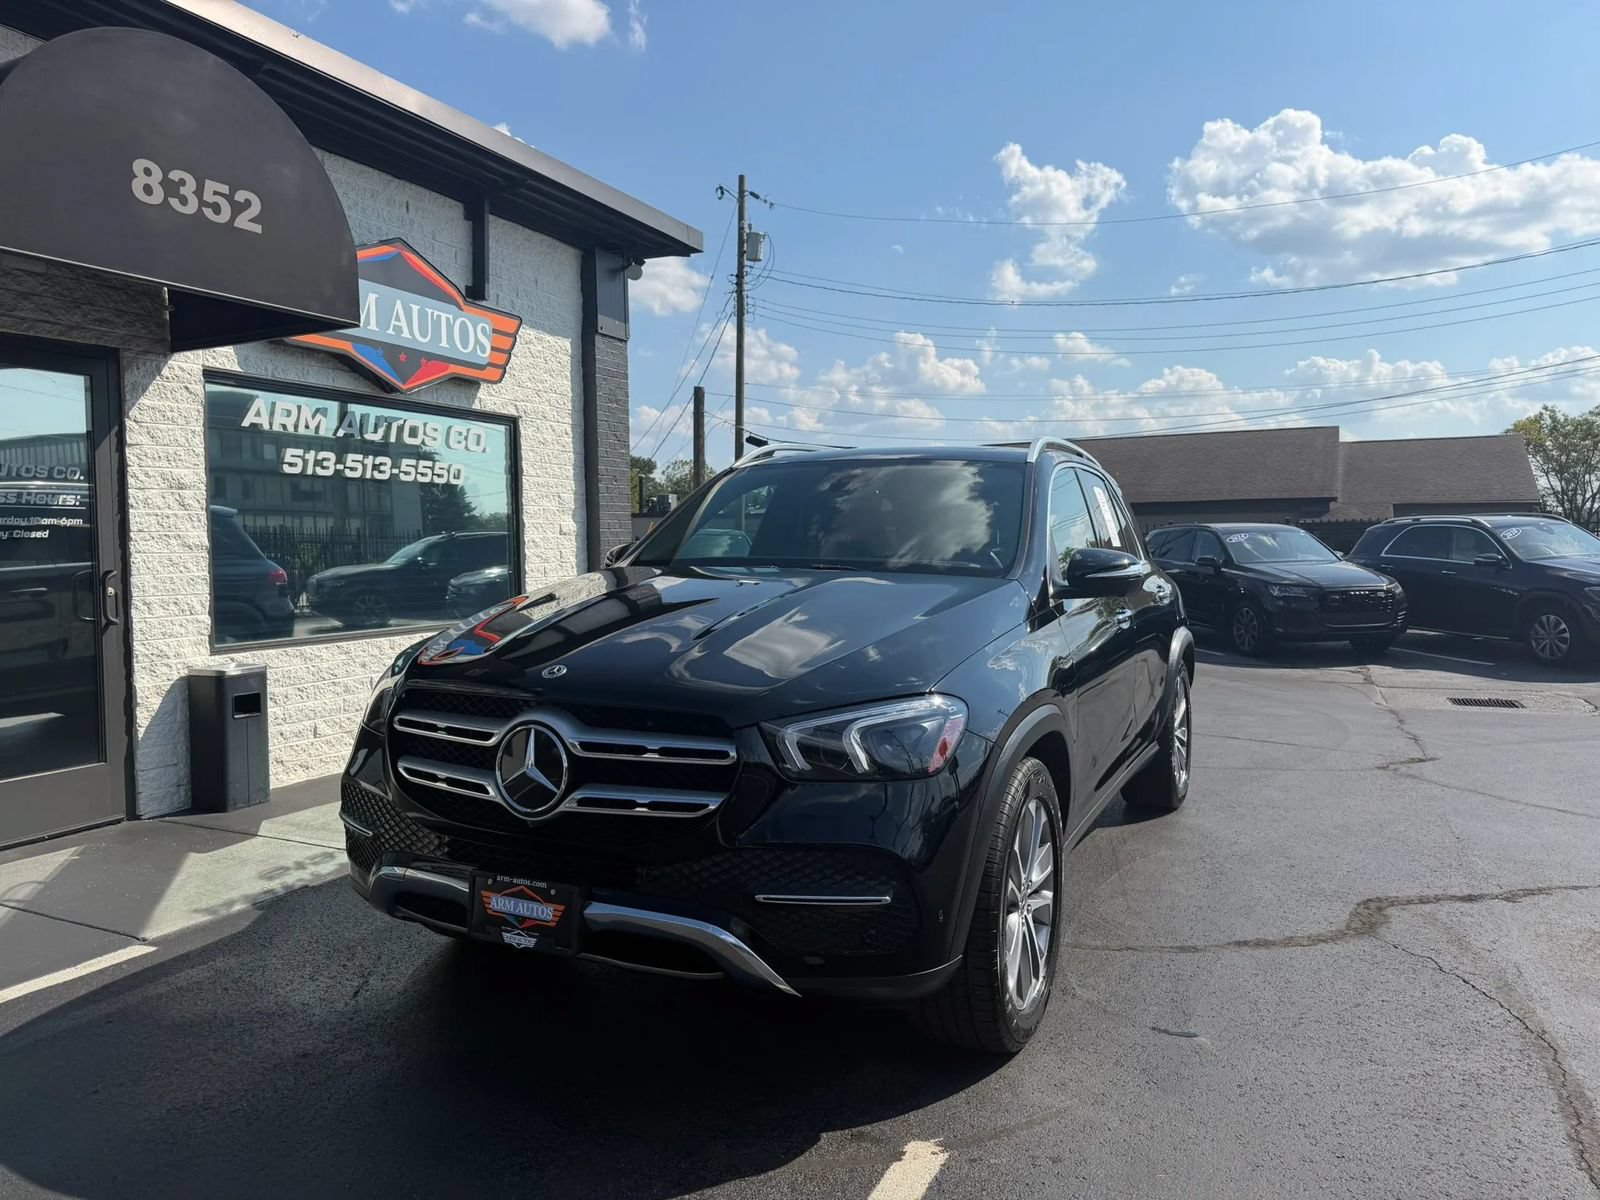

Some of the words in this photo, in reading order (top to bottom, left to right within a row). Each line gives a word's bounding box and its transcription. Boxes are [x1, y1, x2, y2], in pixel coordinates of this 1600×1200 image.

[131, 158, 263, 234] 8352
[387, 299, 491, 358] AUTOS
[241, 399, 327, 435] ARM
[337, 411, 444, 447] AUTOS
[447, 425, 490, 453] CO.
[0, 464, 49, 478] UTOS
[53, 466, 84, 480] CO.
[282, 448, 466, 485] 513-513-5550
[21, 492, 81, 506] Hours:
[13, 530, 49, 538] Closed
[497, 875, 547, 888] arm-autos.com
[490, 897, 514, 912] ARM
[516, 903, 554, 920] AUTOS
